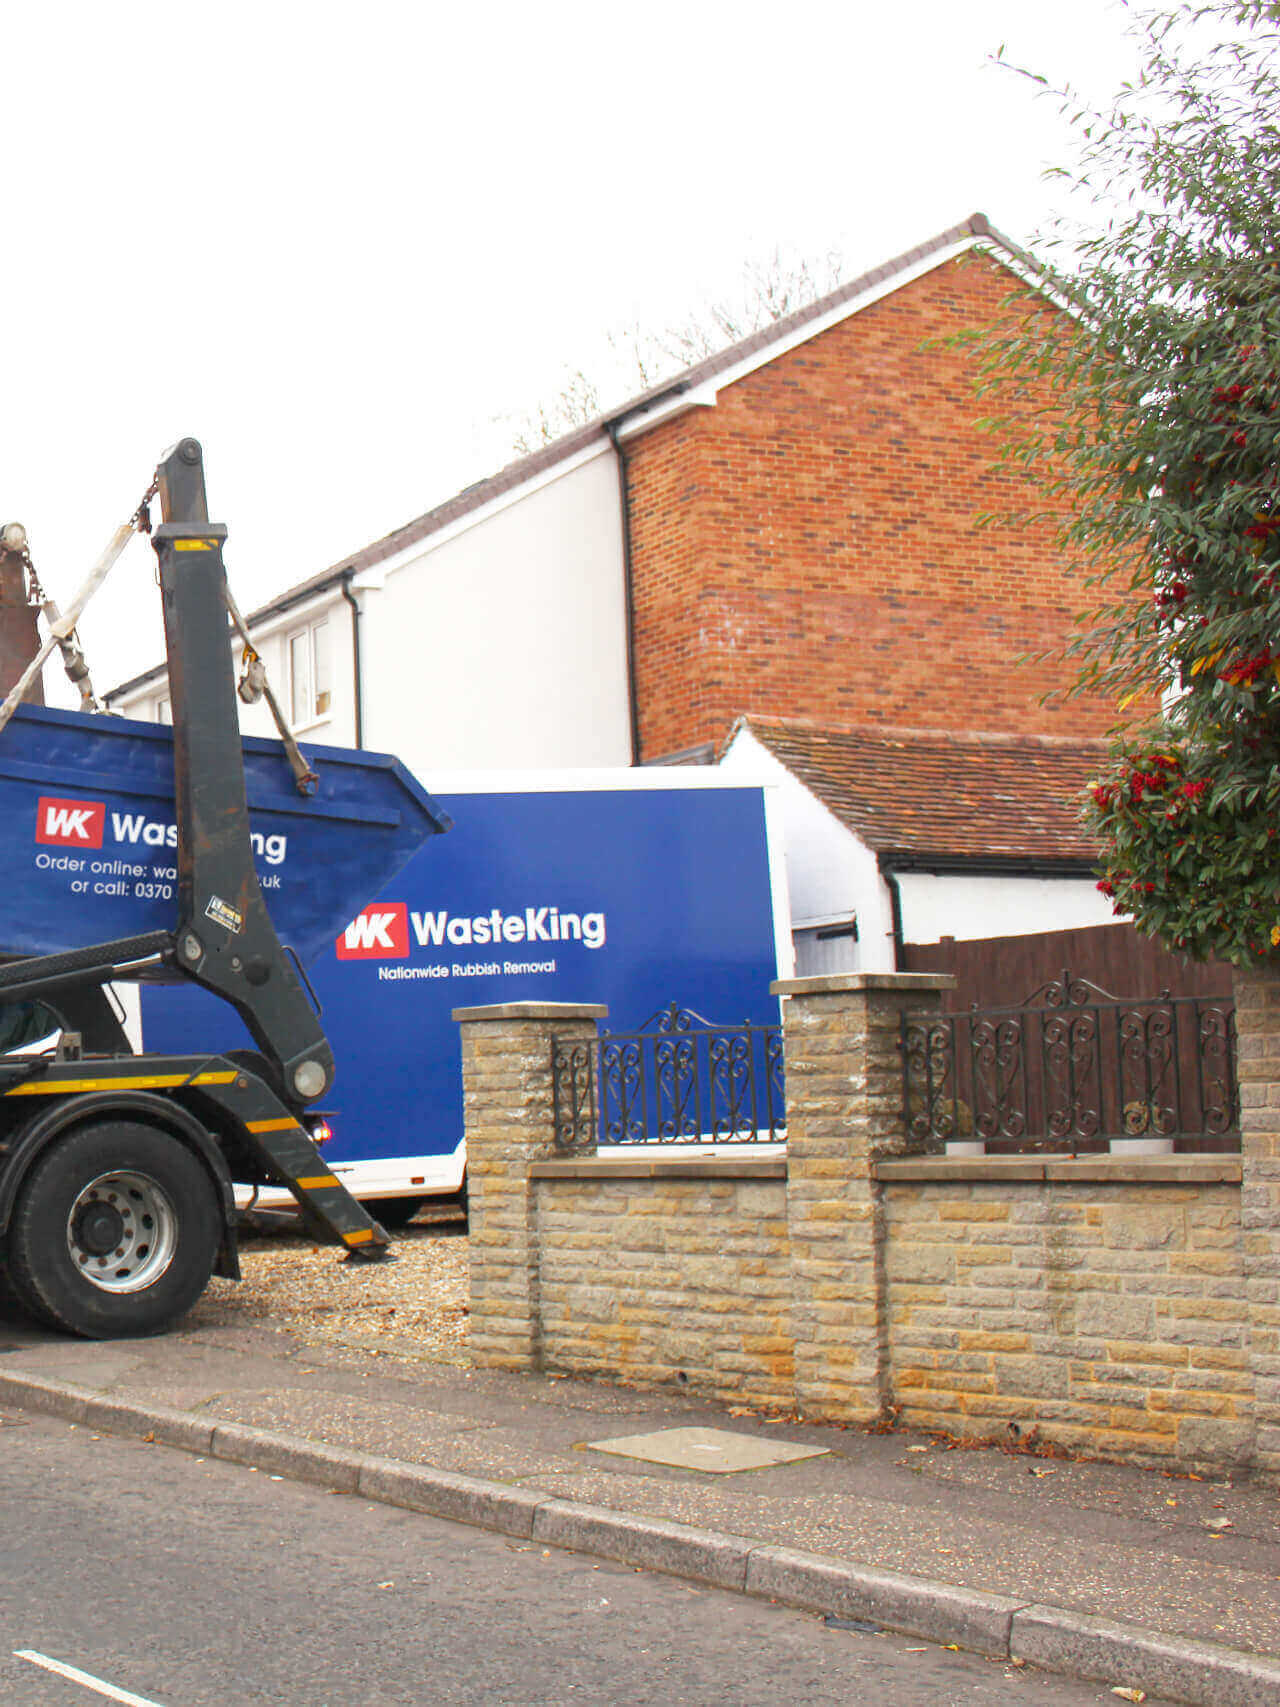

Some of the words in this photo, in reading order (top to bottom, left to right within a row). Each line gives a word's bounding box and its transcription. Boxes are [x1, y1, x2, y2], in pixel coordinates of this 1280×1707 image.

[45, 806, 96, 840] WK
[35, 853, 85, 872] Order
[90, 860, 148, 878] online:
[70, 880, 89, 894] or
[93, 879, 130, 897] call:
[134, 883, 172, 900] 0370
[344, 912, 397, 950] WK
[410, 907, 606, 950] WasteKing
[378, 965, 449, 981] Nationwide
[452, 962, 501, 977] Rubbish
[503, 959, 556, 975] Removal
